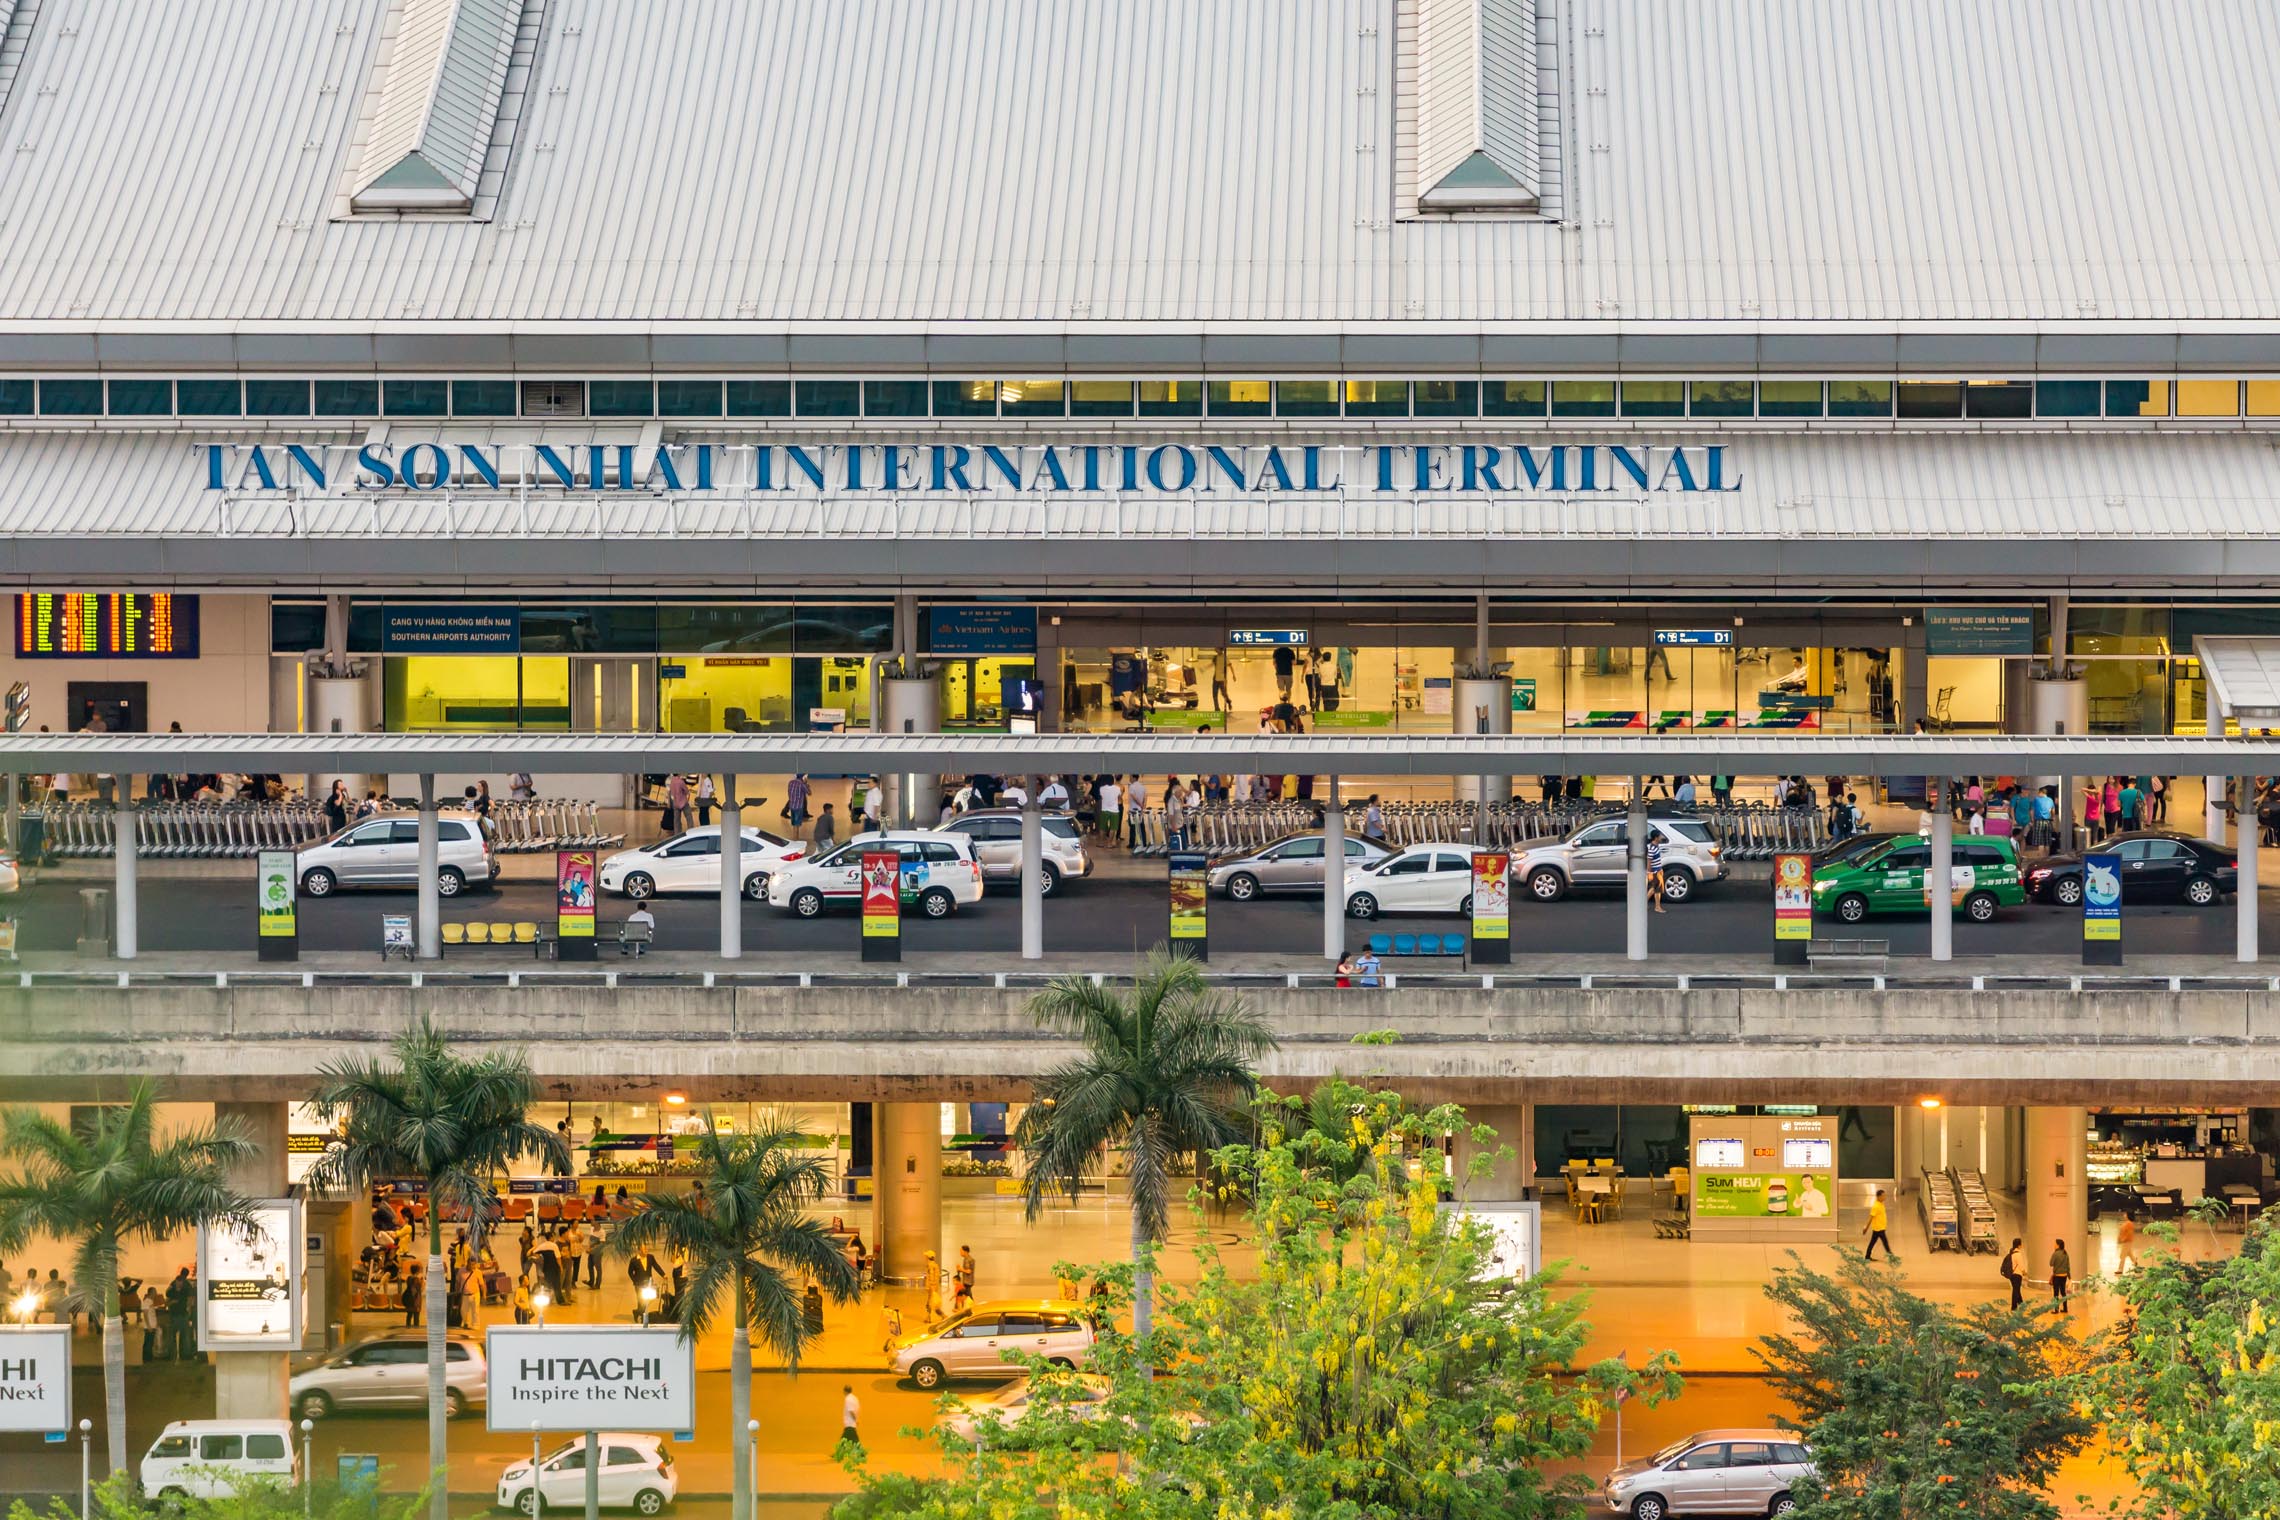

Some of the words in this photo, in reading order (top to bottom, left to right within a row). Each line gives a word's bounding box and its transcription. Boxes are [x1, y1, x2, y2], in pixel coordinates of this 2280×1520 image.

[193, 444, 330, 491] TAN
[355, 443, 503, 491] SON
[531, 444, 727, 491] NHAT
[750, 444, 1341, 492] INTERNATIONAL
[1363, 445, 1743, 492] TERMINAL
[495, 618, 511, 626] NAM
[1289, 632, 1305, 642] D1
[1714, 633, 1729, 642] D1
[520, 1358, 661, 1381] HITACHI
[0, 1384, 45, 1400] Next
[512, 1386, 579, 1404] Inspire
[586, 1386, 617, 1400] the
[624, 1384, 670, 1400] Next
